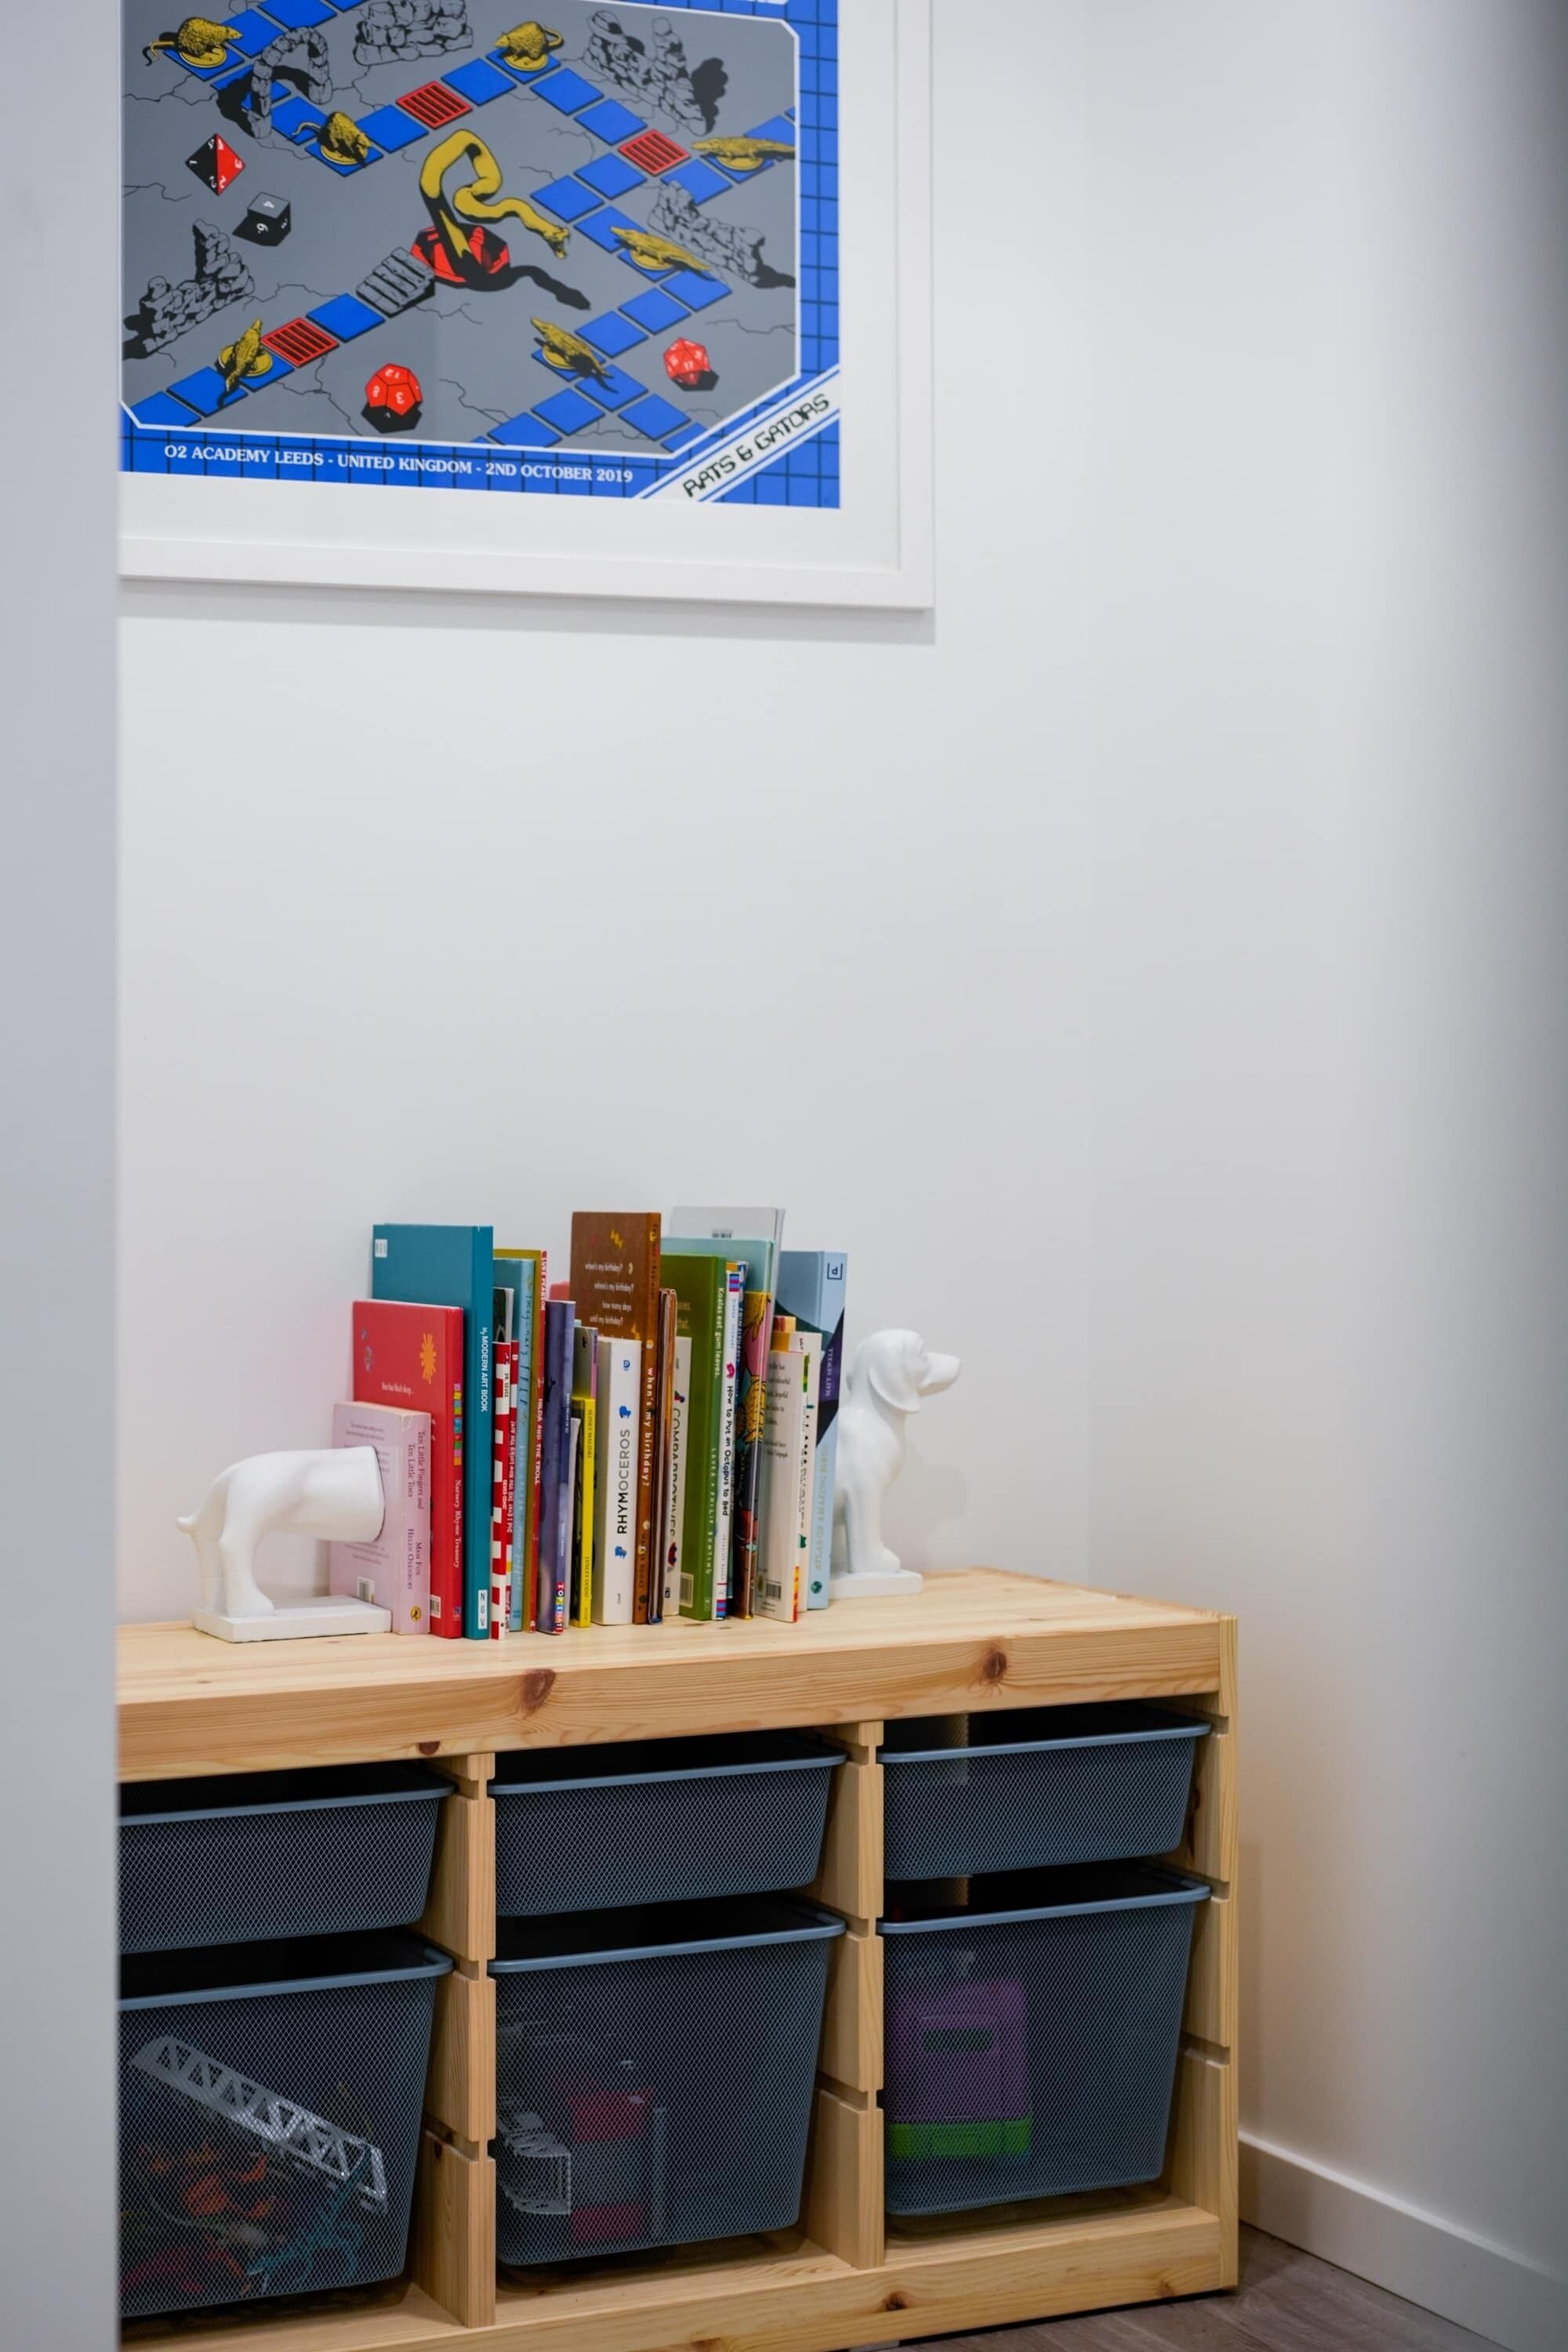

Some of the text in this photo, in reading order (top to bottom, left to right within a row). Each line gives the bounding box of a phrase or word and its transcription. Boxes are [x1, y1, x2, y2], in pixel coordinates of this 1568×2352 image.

[395, 391, 405, 405] 3
[683, 393, 830, 498] RATS & GATORS
[164, 445, 187, 459] O2
[192, 446, 270, 463] ACADEMY
[274, 451, 324, 466] LEEDS
[337, 455, 394, 470] UNITED
[398, 458, 472, 474] KINGDOM
[486, 463, 517, 477] 2ND
[521, 464, 593, 481] OCTOBER
[597, 468, 633, 483] 2019
[717, 1287, 725, 1314] Koalas
[641, 1367, 655, 1486] when's my birthday?
[726, 1409, 732, 1417] to
[725, 1437, 731, 1446] an
[416, 1468, 426, 1496] Fingers
[616, 1429, 630, 1534] RHYMOCEROS
[723, 1450, 731, 1485] Octopus
[723, 1489, 730, 1497] to
[453, 1479, 462, 1569] Nursery Rhyme Treasury
